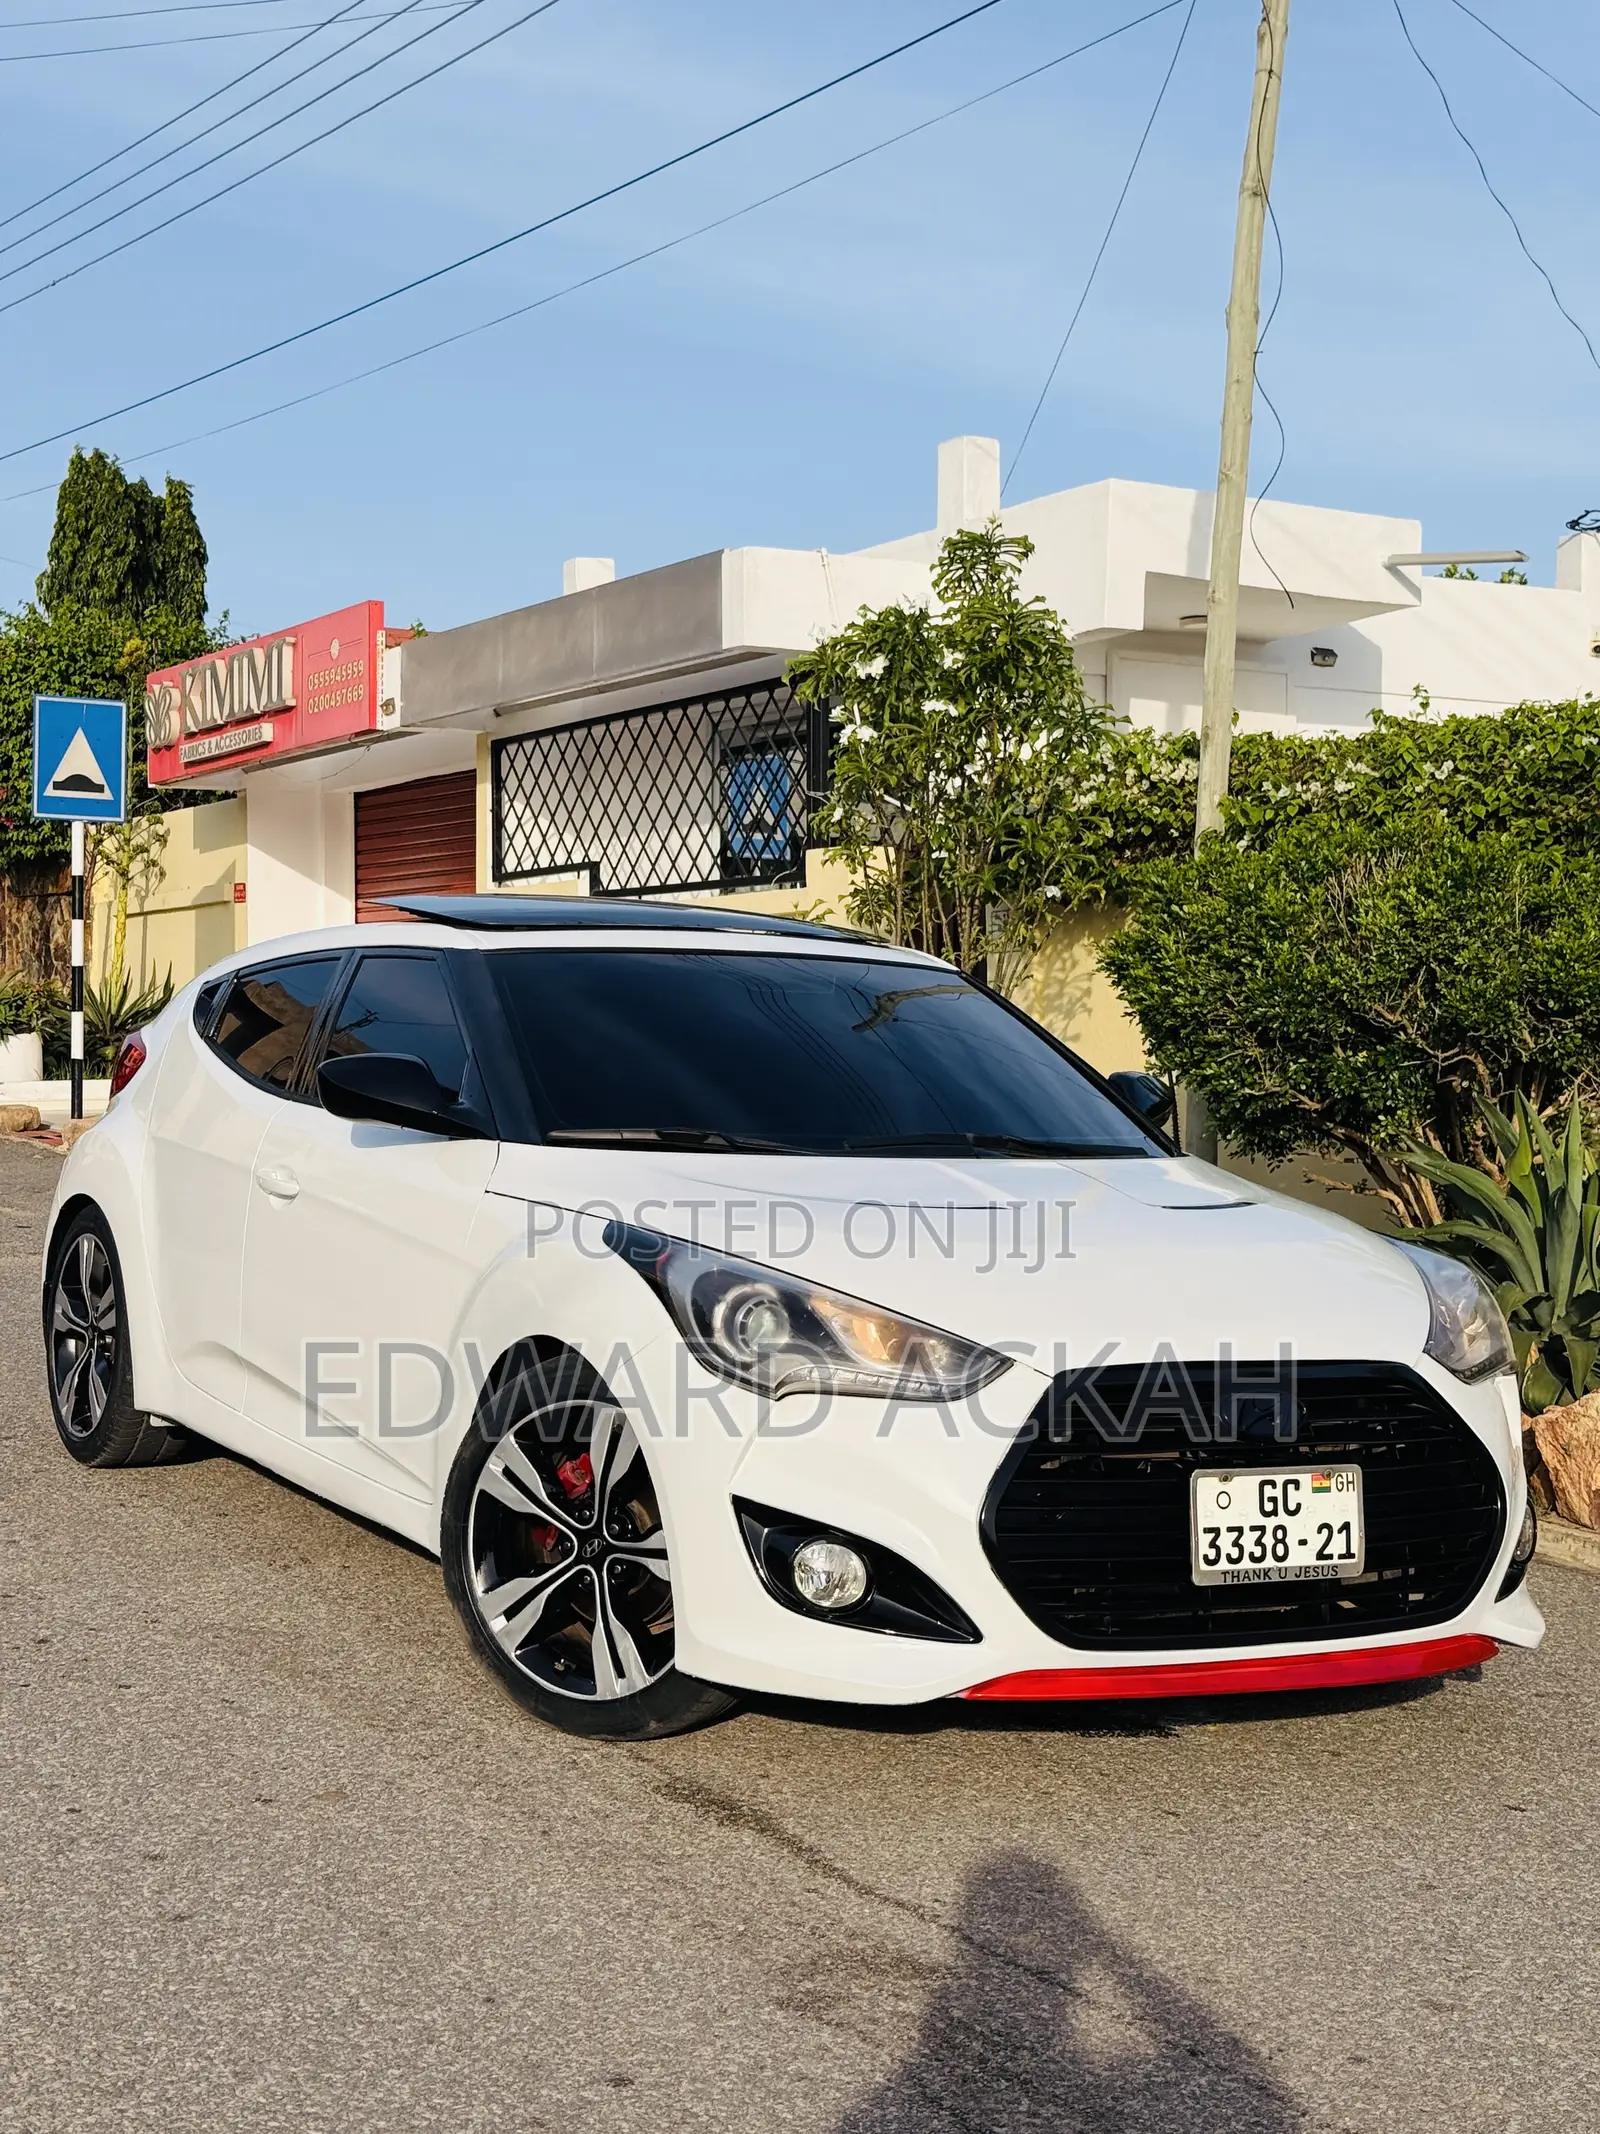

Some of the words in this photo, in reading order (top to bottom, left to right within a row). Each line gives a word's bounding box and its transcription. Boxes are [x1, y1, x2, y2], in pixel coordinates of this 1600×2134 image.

[308, 660, 364, 691] 0555945959
[308, 684, 364, 715] 0200457669
[179, 742, 207, 761] FABRICS
[207, 741, 213, 754] &
[214, 726, 263, 753] ACCESSORIES
[1258, 1478, 1302, 1518] GC
[1335, 1473, 1356, 1492] GH
[1220, 1568, 1273, 1583] THANK
[1278, 1567, 1288, 1579] U
[1294, 1565, 1339, 1578] JESUS
